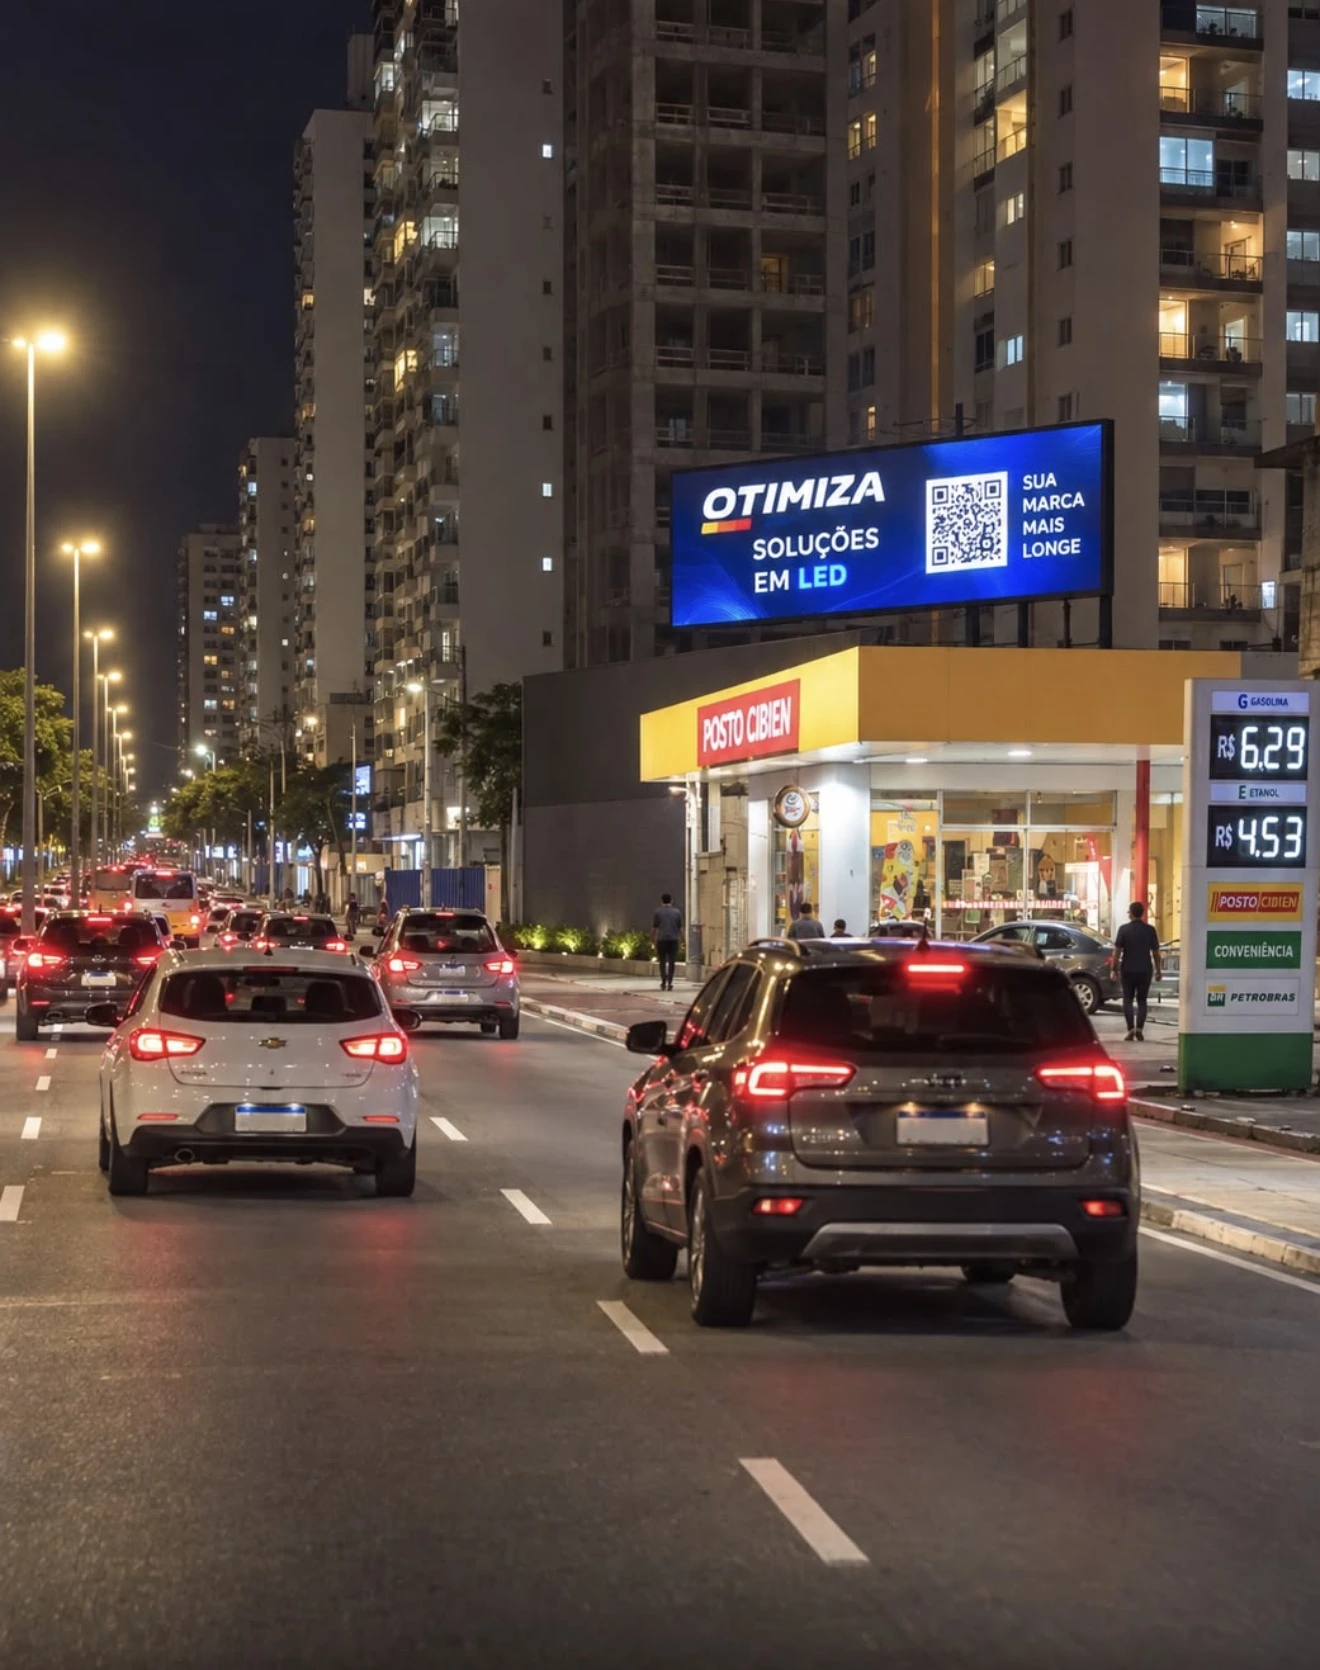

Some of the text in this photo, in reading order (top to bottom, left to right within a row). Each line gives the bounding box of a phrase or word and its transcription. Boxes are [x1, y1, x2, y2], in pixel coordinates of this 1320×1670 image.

[1022, 472, 1057, 490] SUA
[702, 471, 885, 520] OTIMIZA
[1022, 491, 1085, 513] MARCA
[1022, 517, 1065, 536] MAIS
[752, 525, 879, 561] SOLUÇÕES
[1022, 538, 1081, 559] LONGE
[754, 564, 848, 593] EM LED
[1238, 693, 1248, 709] G
[703, 696, 792, 753] POSTO CIBIEN
[1217, 734, 1236, 761] R$
[1238, 785, 1280, 800] E ETANOL
[1215, 824, 1233, 850] R$
[1219, 896, 1258, 909] POSTO
[1214, 942, 1294, 958] CONVENIÊNCIA
[1230, 992, 1296, 1003] PETROBRAS
